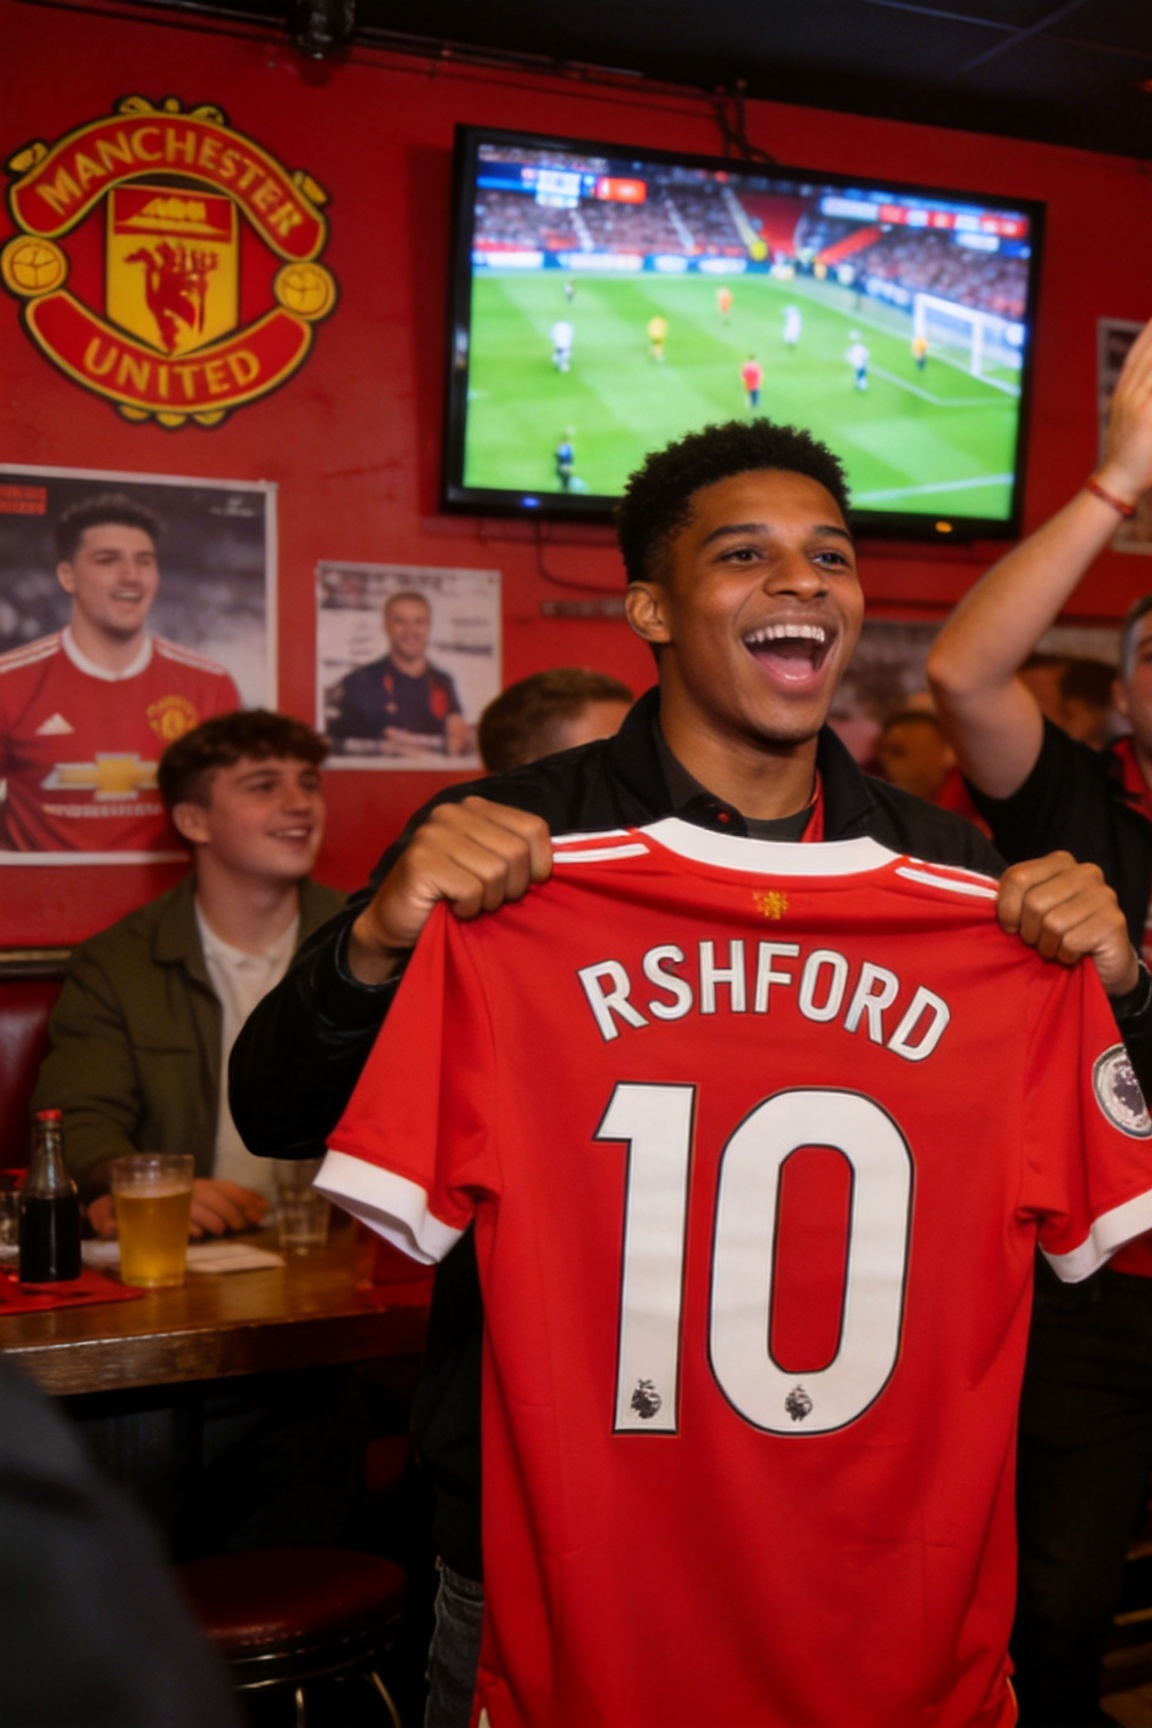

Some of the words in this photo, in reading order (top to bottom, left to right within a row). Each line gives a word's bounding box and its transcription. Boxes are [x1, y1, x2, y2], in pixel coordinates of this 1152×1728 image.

[37, 127, 303, 237] MANCHESTER
[84, 338, 259, 398] UNITED
[577, 939, 950, 1062] RSHFORD
[593, 1081, 914, 1436] 10
